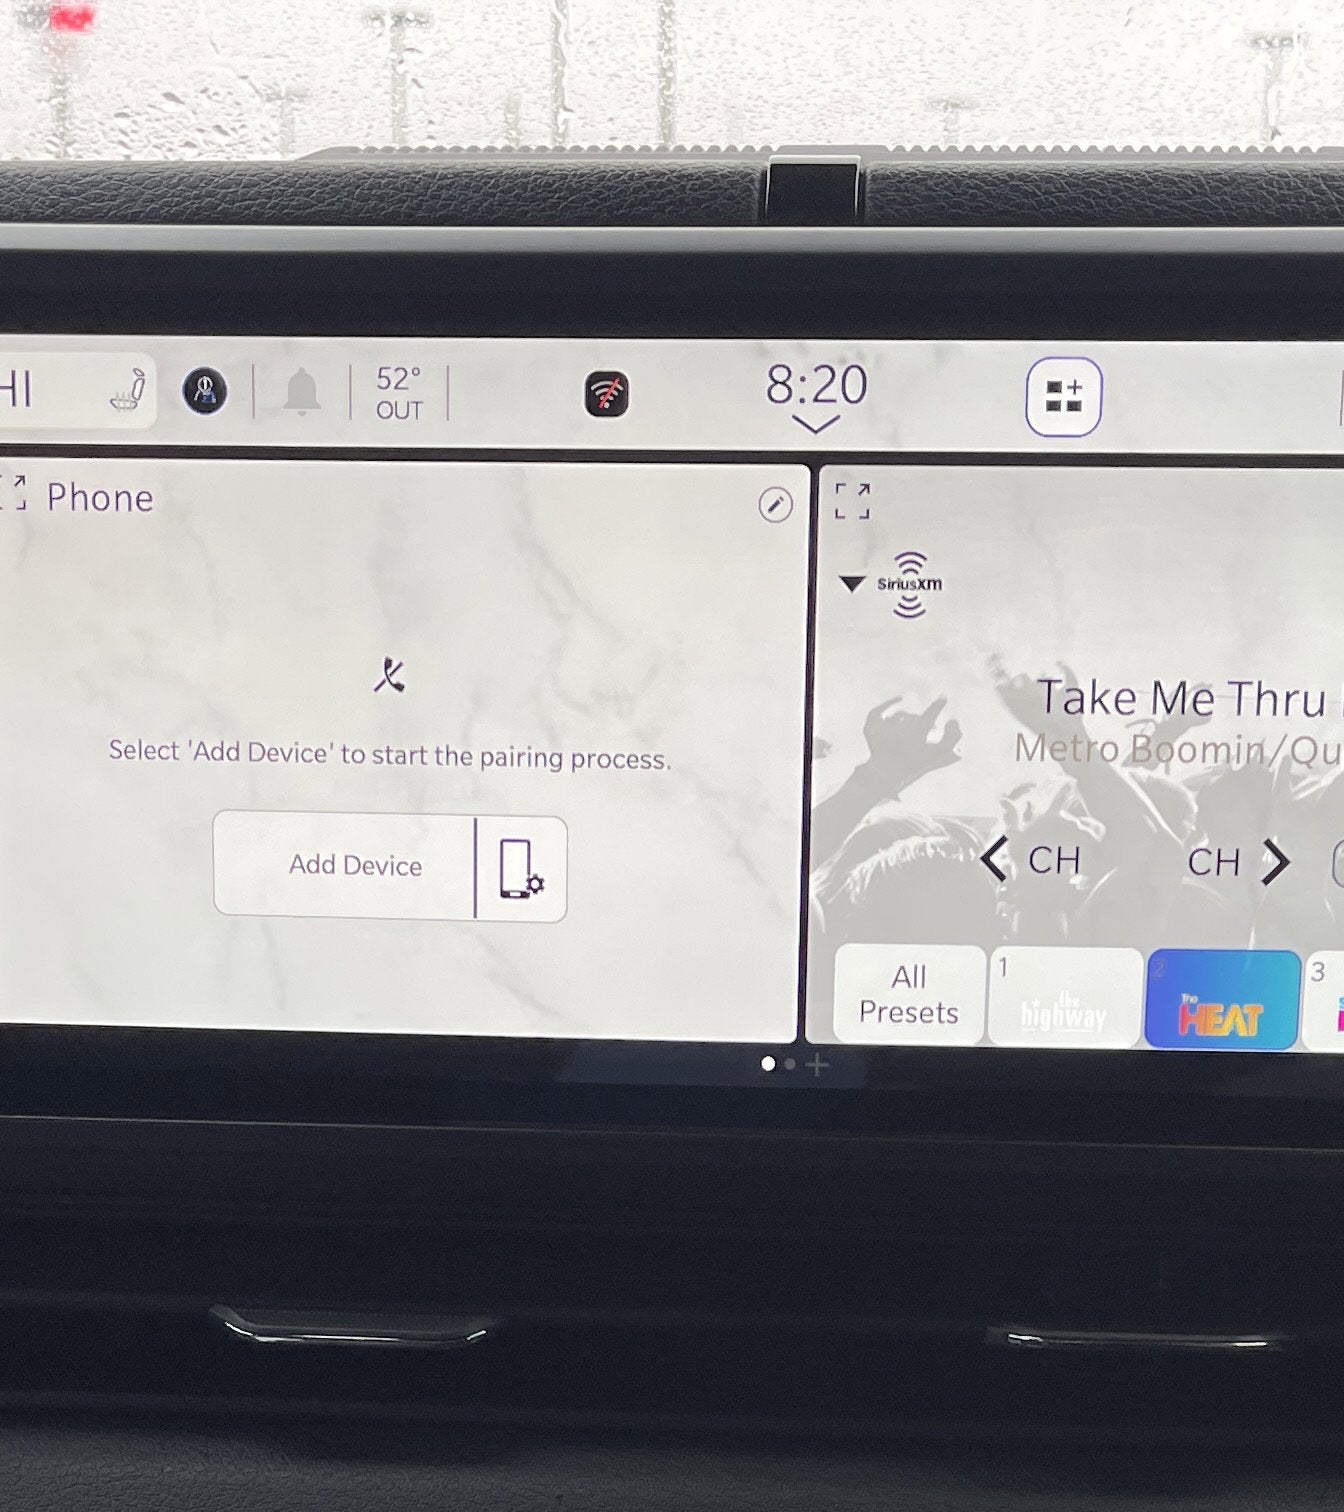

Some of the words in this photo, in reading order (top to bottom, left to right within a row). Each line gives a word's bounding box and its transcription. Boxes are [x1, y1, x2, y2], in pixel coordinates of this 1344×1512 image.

[377, 367, 420, 390] 52°
[767, 364, 867, 405] 8:20
[377, 401, 423, 420] OUT
[48, 482, 154, 512] Phone
[1038, 679, 1136, 716] Take
[1152, 679, 1214, 717] Me
[1227, 680, 1324, 718] Thru
[109, 739, 179, 761] Select
[188, 740, 240, 762] 'Add
[249, 741, 334, 764] Device'
[341, 744, 365, 765] to
[372, 744, 428, 766] start
[435, 744, 473, 767] the
[481, 745, 563, 773] pairing
[571, 751, 672, 773] process.
[1016, 732, 1119, 763] Metro
[289, 853, 336, 875] Add
[344, 855, 423, 877] Device
[1029, 847, 1080, 875] CH
[1189, 848, 1241, 877] CH
[891, 964, 926, 988] All
[999, 957, 1008, 978] 1
[1310, 962, 1326, 982] 3
[860, 1000, 959, 1024] Presets
[1021, 999, 1107, 1031] highway
[1179, 1003, 1264, 1036] HEAT
